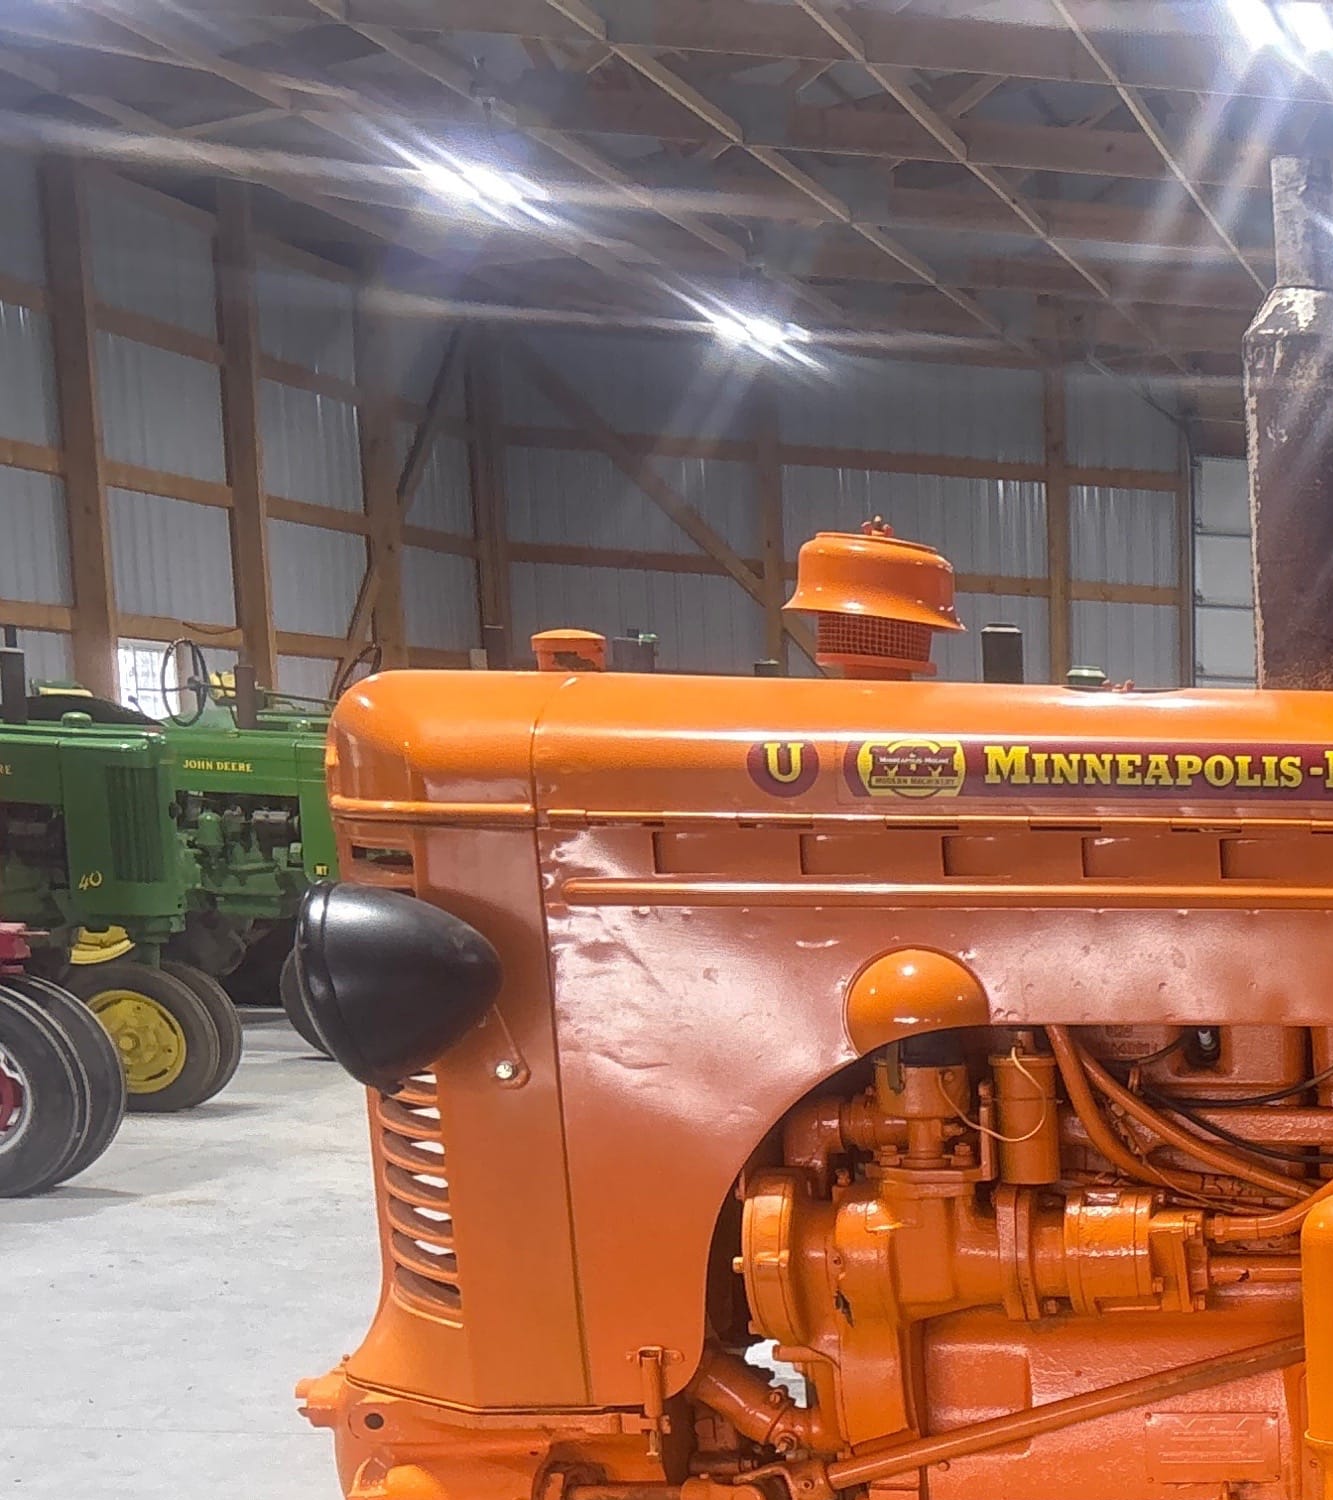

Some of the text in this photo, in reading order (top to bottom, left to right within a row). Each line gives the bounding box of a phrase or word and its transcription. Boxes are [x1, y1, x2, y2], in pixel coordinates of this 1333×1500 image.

[183, 759, 253, 773] JOHN DEERE
[762, 742, 804, 783] U
[79, 871, 103, 891] 40
